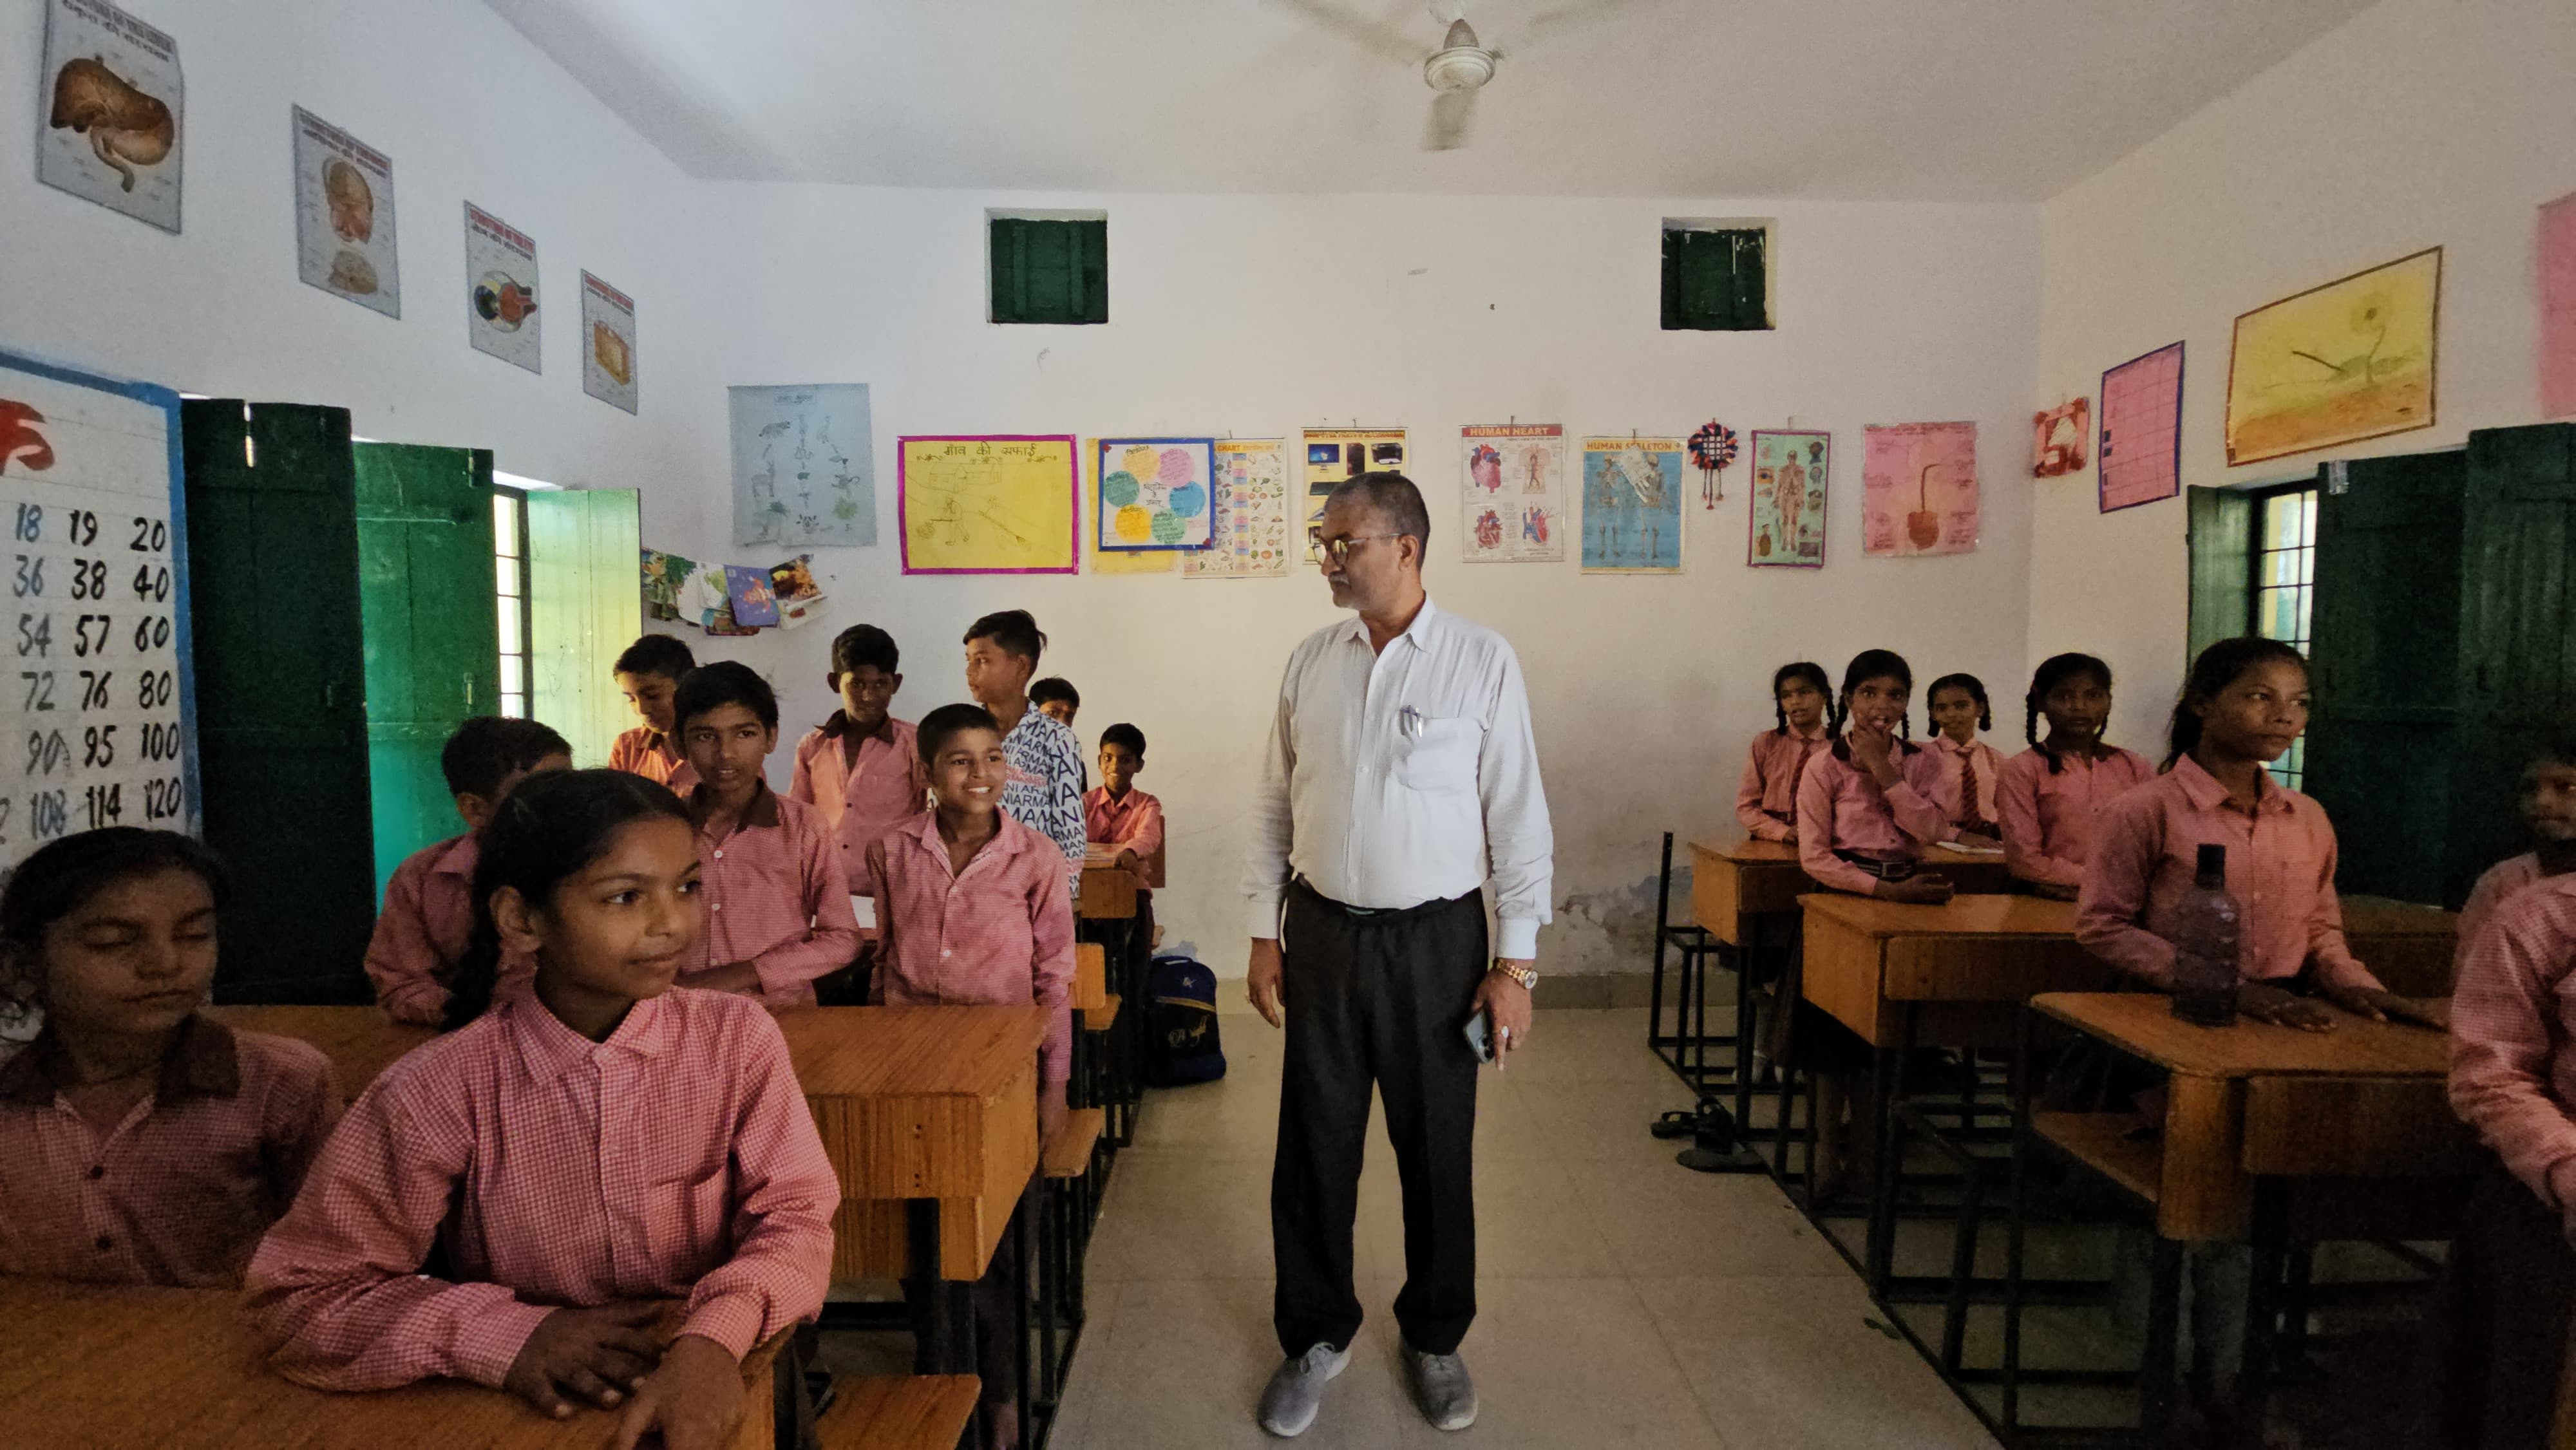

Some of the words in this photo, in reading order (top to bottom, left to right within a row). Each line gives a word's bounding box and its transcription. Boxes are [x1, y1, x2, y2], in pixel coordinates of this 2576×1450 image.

[976, 440, 992, 455] की
[1001, 442, 1037, 457] सफाई
[1470, 428, 1510, 436] HUMAN
[1513, 427, 1549, 435] HEART
[1586, 442, 1622, 450] HUMAN
[1625, 442, 1671, 450] SLETON
[15, 502, 43, 543] 18
[68, 510, 98, 547] 19
[129, 517, 166, 552] 20
[13, 555, 44, 598] 36
[71, 558, 107, 601] 38
[133, 564, 169, 603] 40
[17, 614, 52, 658] 54
[74, 615, 110, 657] 57
[134, 616, 169, 652] 60
[21, 672, 55, 712] 72
[80, 671, 112, 711] 76
[138, 670, 172, 709] 80
[83, 726, 117, 768] 95
[141, 721, 179, 761] 100
[30, 789, 66, 839] 108
[85, 783, 122, 829] 114
[144, 777, 182, 822] 120
